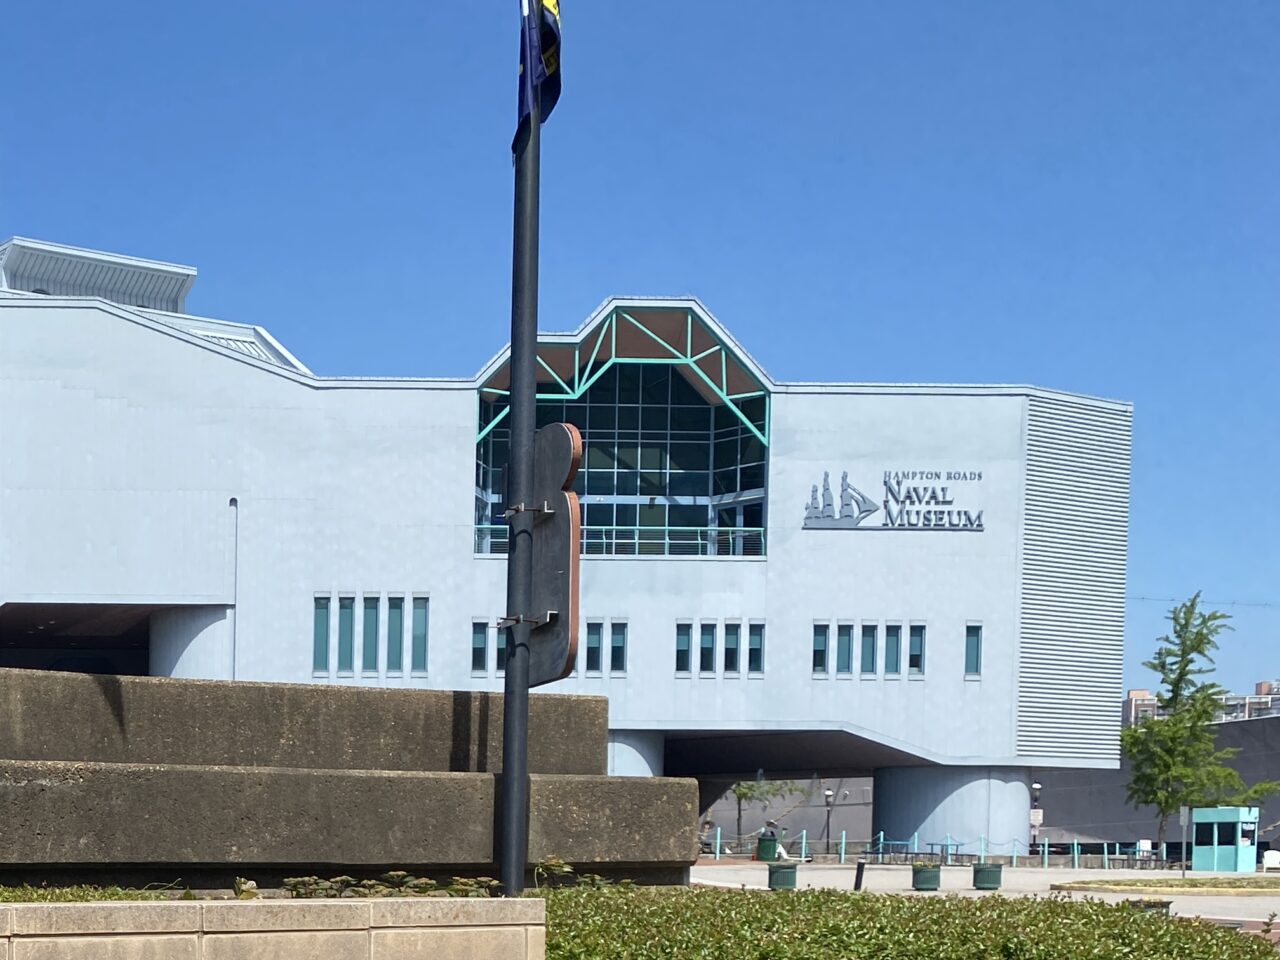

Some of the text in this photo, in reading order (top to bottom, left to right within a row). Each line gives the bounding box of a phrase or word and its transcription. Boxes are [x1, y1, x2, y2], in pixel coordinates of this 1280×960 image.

[883, 470, 983, 481] HAMPTON ROADS
[883, 480, 955, 506] NAVAL
[882, 501, 984, 528] MUSEUM
